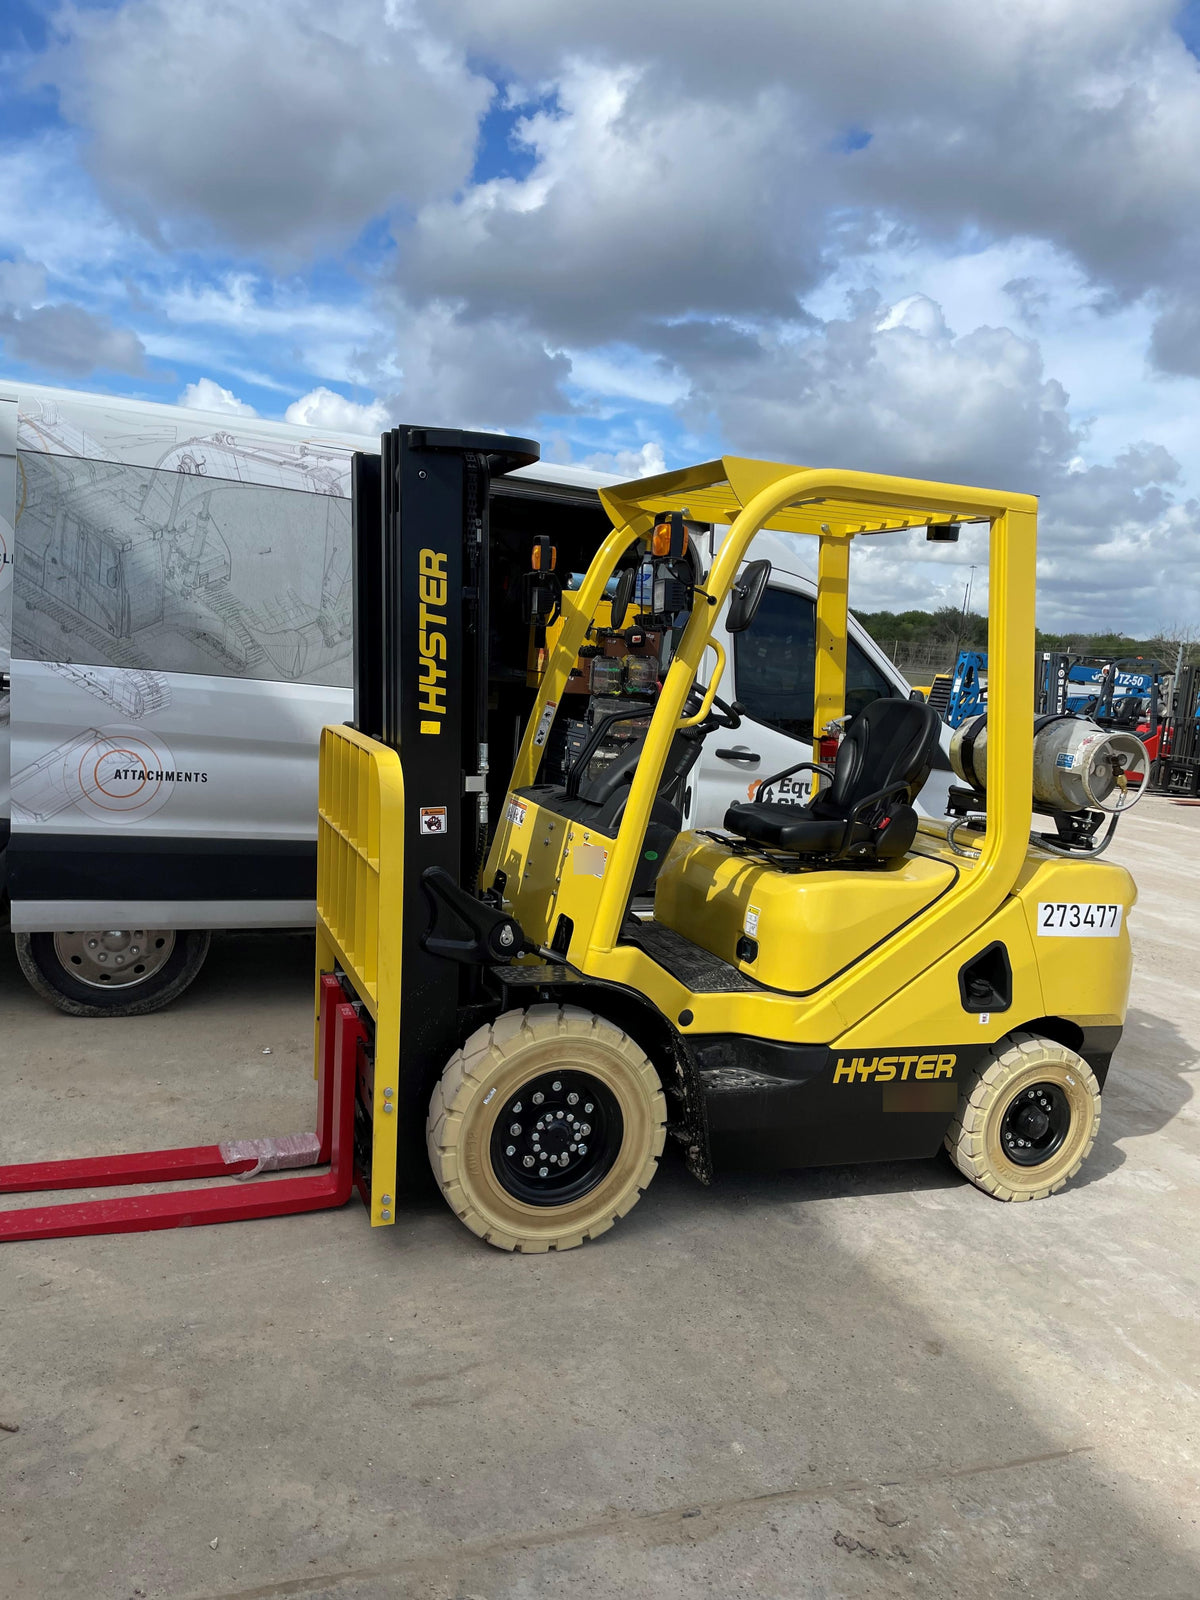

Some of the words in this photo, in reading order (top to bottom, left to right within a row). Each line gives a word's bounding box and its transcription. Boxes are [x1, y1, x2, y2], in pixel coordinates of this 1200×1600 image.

[419, 548, 447, 714] HYSTER
[1118, 674, 1144, 687] TZ-50
[113, 768, 208, 783] ATTACHMENTS
[1043, 904, 1119, 928] 273477
[833, 1054, 957, 1083] HYSTER
